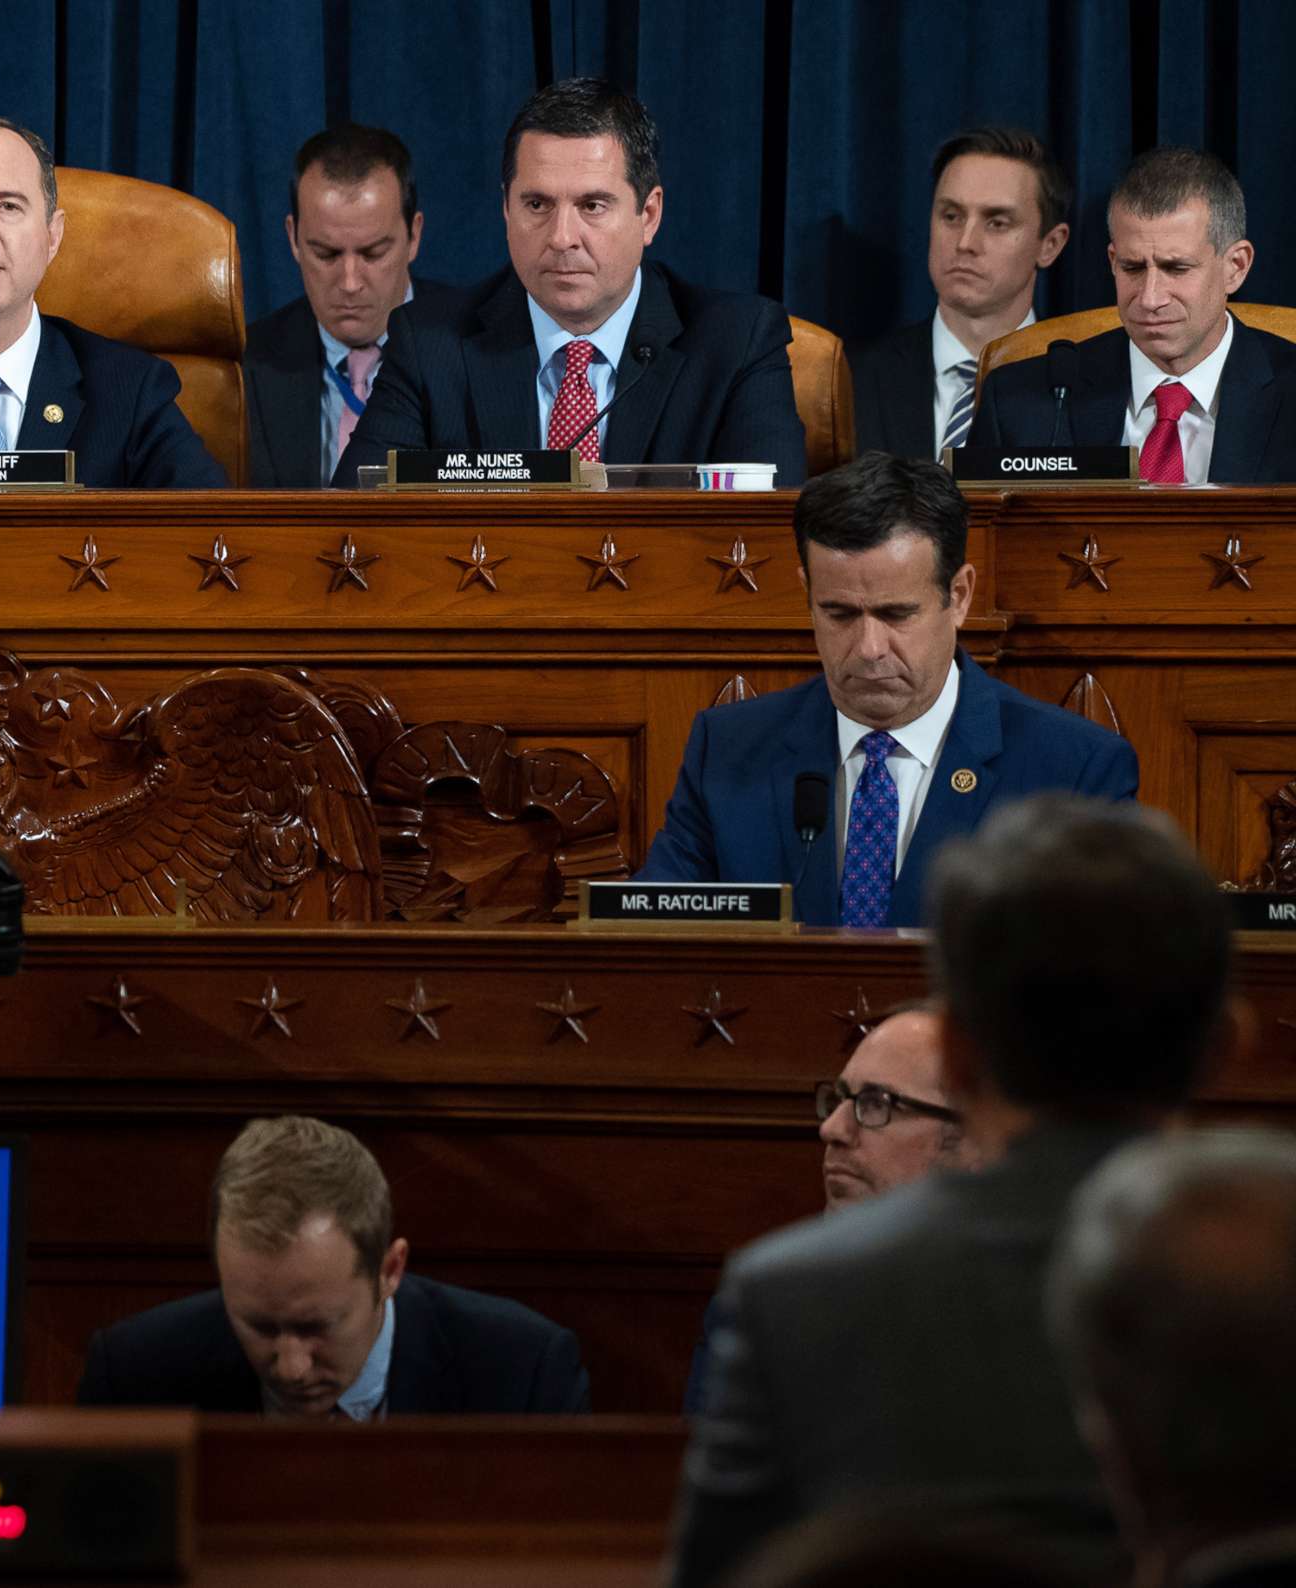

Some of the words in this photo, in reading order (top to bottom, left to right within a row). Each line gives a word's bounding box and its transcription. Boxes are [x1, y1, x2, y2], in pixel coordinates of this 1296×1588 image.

[445, 454, 472, 468] MR.
[476, 453, 524, 468] NUNES
[1000, 457, 1078, 472] COUNSEL
[437, 468, 485, 480] RANKING
[486, 468, 532, 480] MEMBER
[622, 894, 653, 910] MR.
[658, 894, 750, 912] RATCLIFFE
